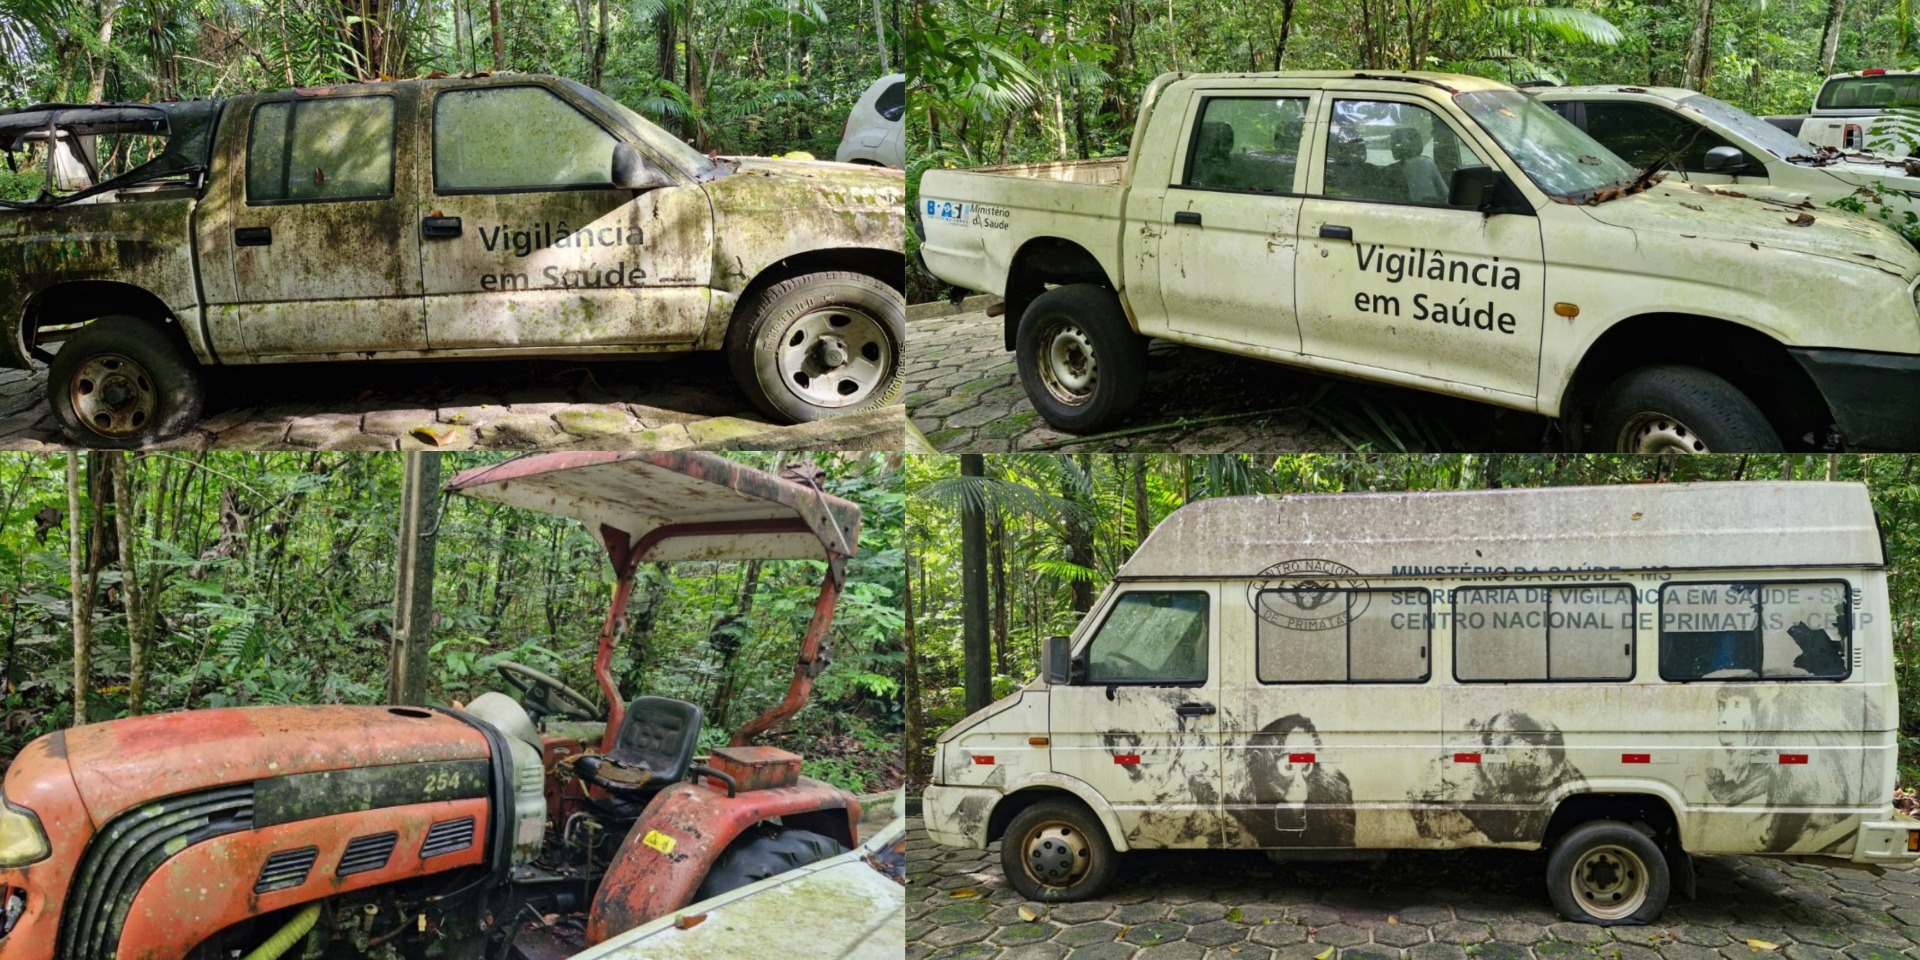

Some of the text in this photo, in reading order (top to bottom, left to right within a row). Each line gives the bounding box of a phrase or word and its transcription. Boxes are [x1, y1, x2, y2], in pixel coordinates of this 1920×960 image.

[970, 204, 1010, 218] Ministério
[984, 215, 1009, 231] Saúde
[479, 219, 644, 257] Vigilância
[480, 262, 647, 291] em Saúde
[1354, 242, 1521, 291] Vigilância
[1354, 291, 1516, 335] em Saúde
[1253, 561, 1300, 590] CNTRO
[1391, 562, 1508, 581] MINISTÉRIO
[1514, 566, 1543, 581] DA
[1548, 562, 1620, 581] SAÚDE
[1641, 566, 1672, 581] MS
[1391, 588, 1519, 605] SECRETARIA
[1526, 588, 1552, 604] DE
[1559, 587, 1681, 605] VIGILÂNCA
[1687, 588, 1717, 605] EM
[1262, 610, 1279, 623] DE
[1390, 611, 1485, 630] CENTRO
[1493, 611, 1614, 630] NACIONAL
[1622, 612, 1653, 630] DE
[1662, 612, 1784, 631] PRIMATAS
[423, 771, 460, 793] 254
